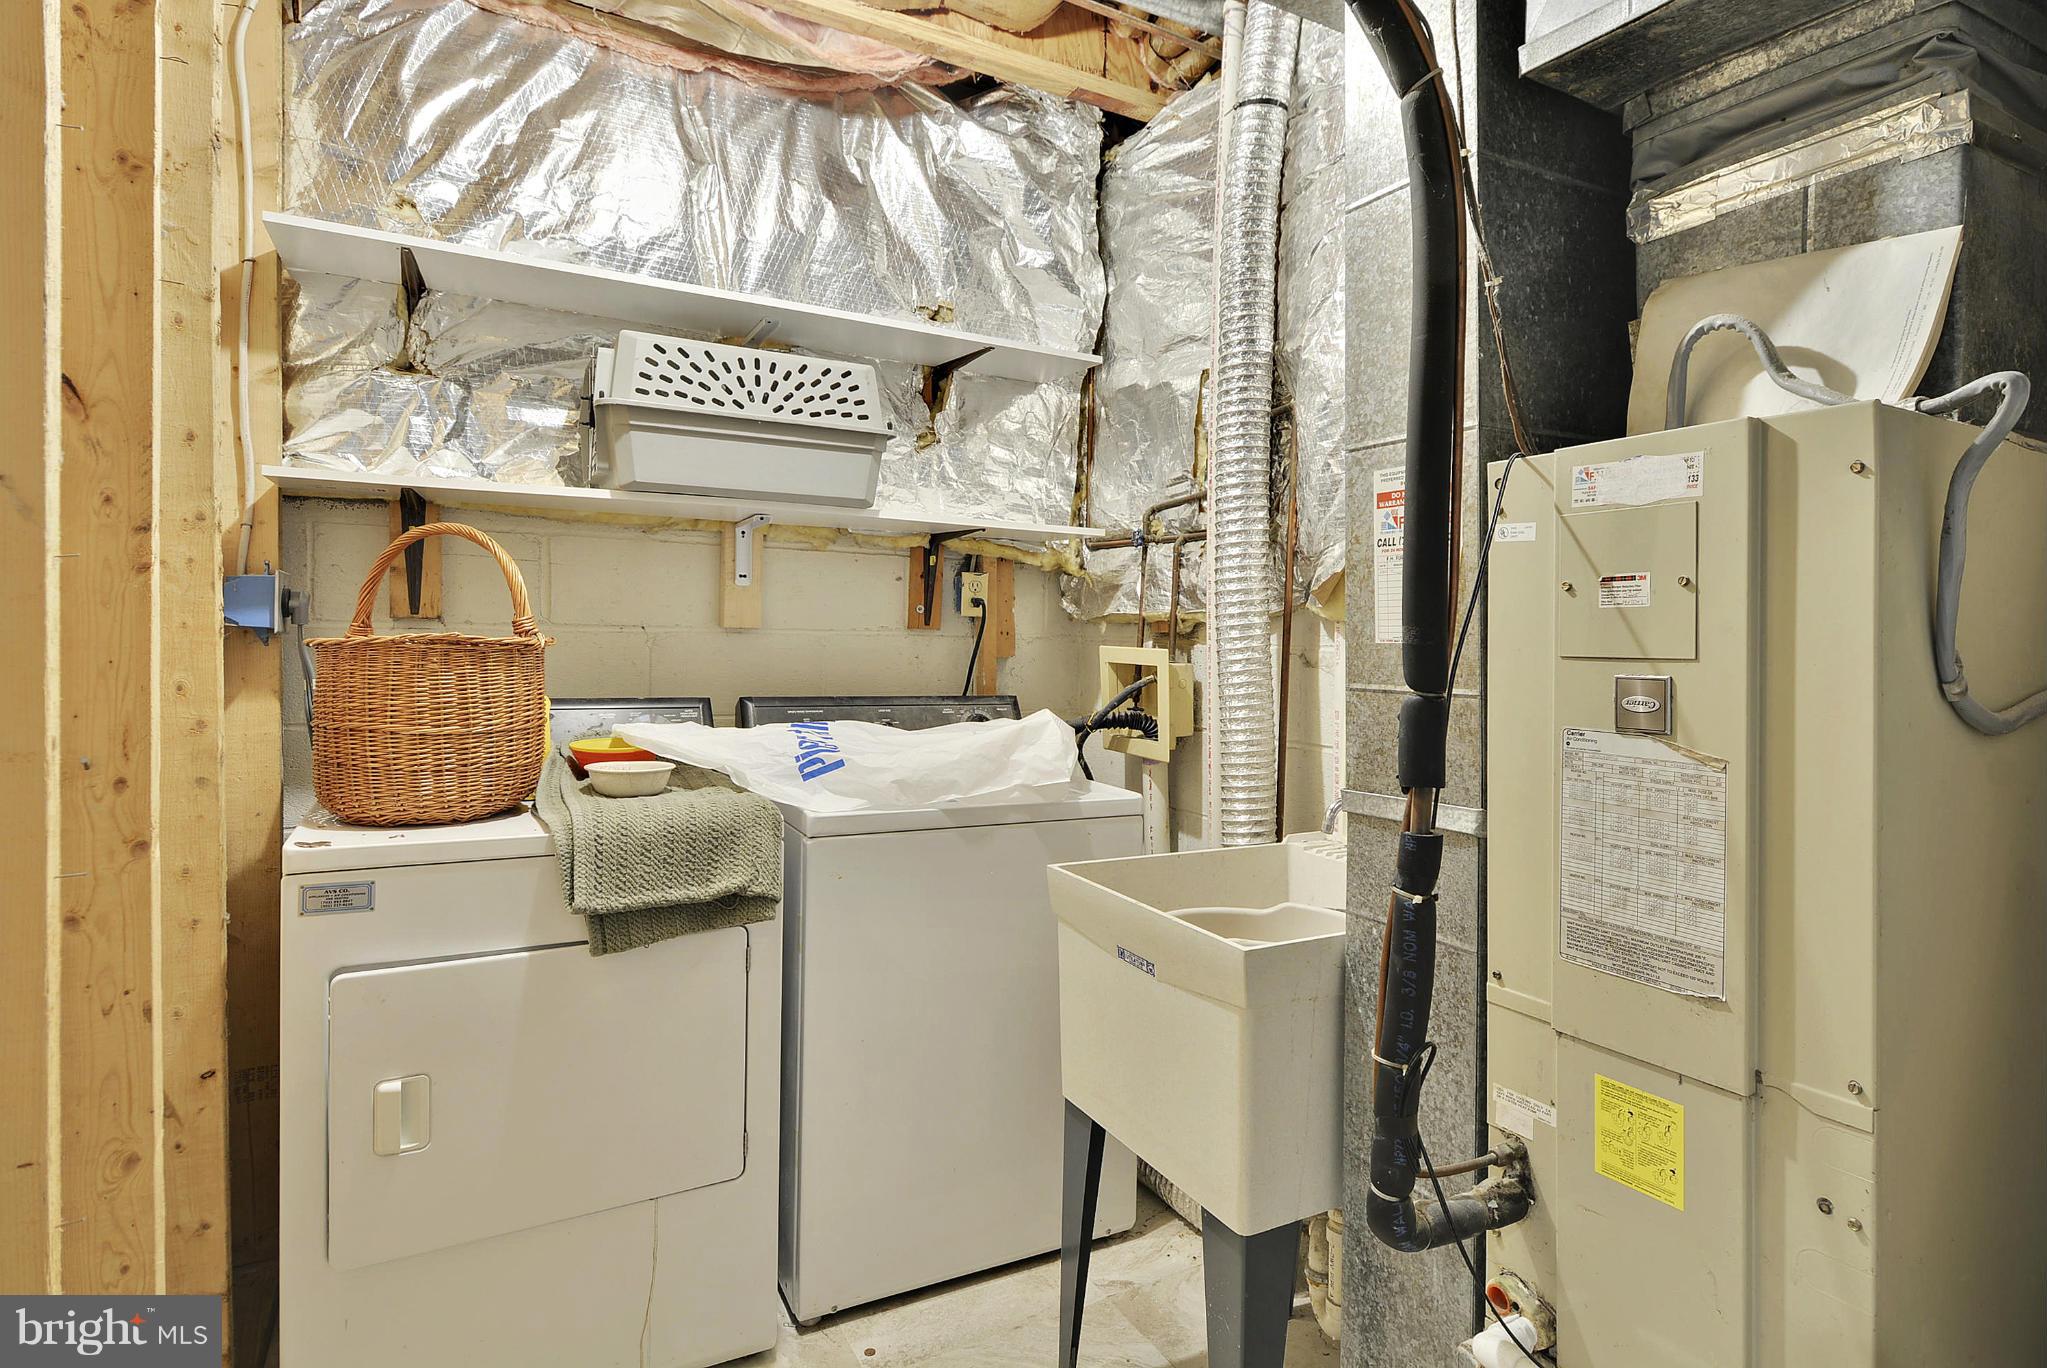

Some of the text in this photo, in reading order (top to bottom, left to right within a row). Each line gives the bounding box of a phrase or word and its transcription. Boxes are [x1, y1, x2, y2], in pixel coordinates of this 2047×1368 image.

[1378, 499, 1405, 507] WARRAN
[1377, 537, 1396, 548] CALL
[1625, 699, 1656, 709] Carrier
[1401, 929, 1417, 962] NOM
[1400, 970, 1417, 998] 3/8
